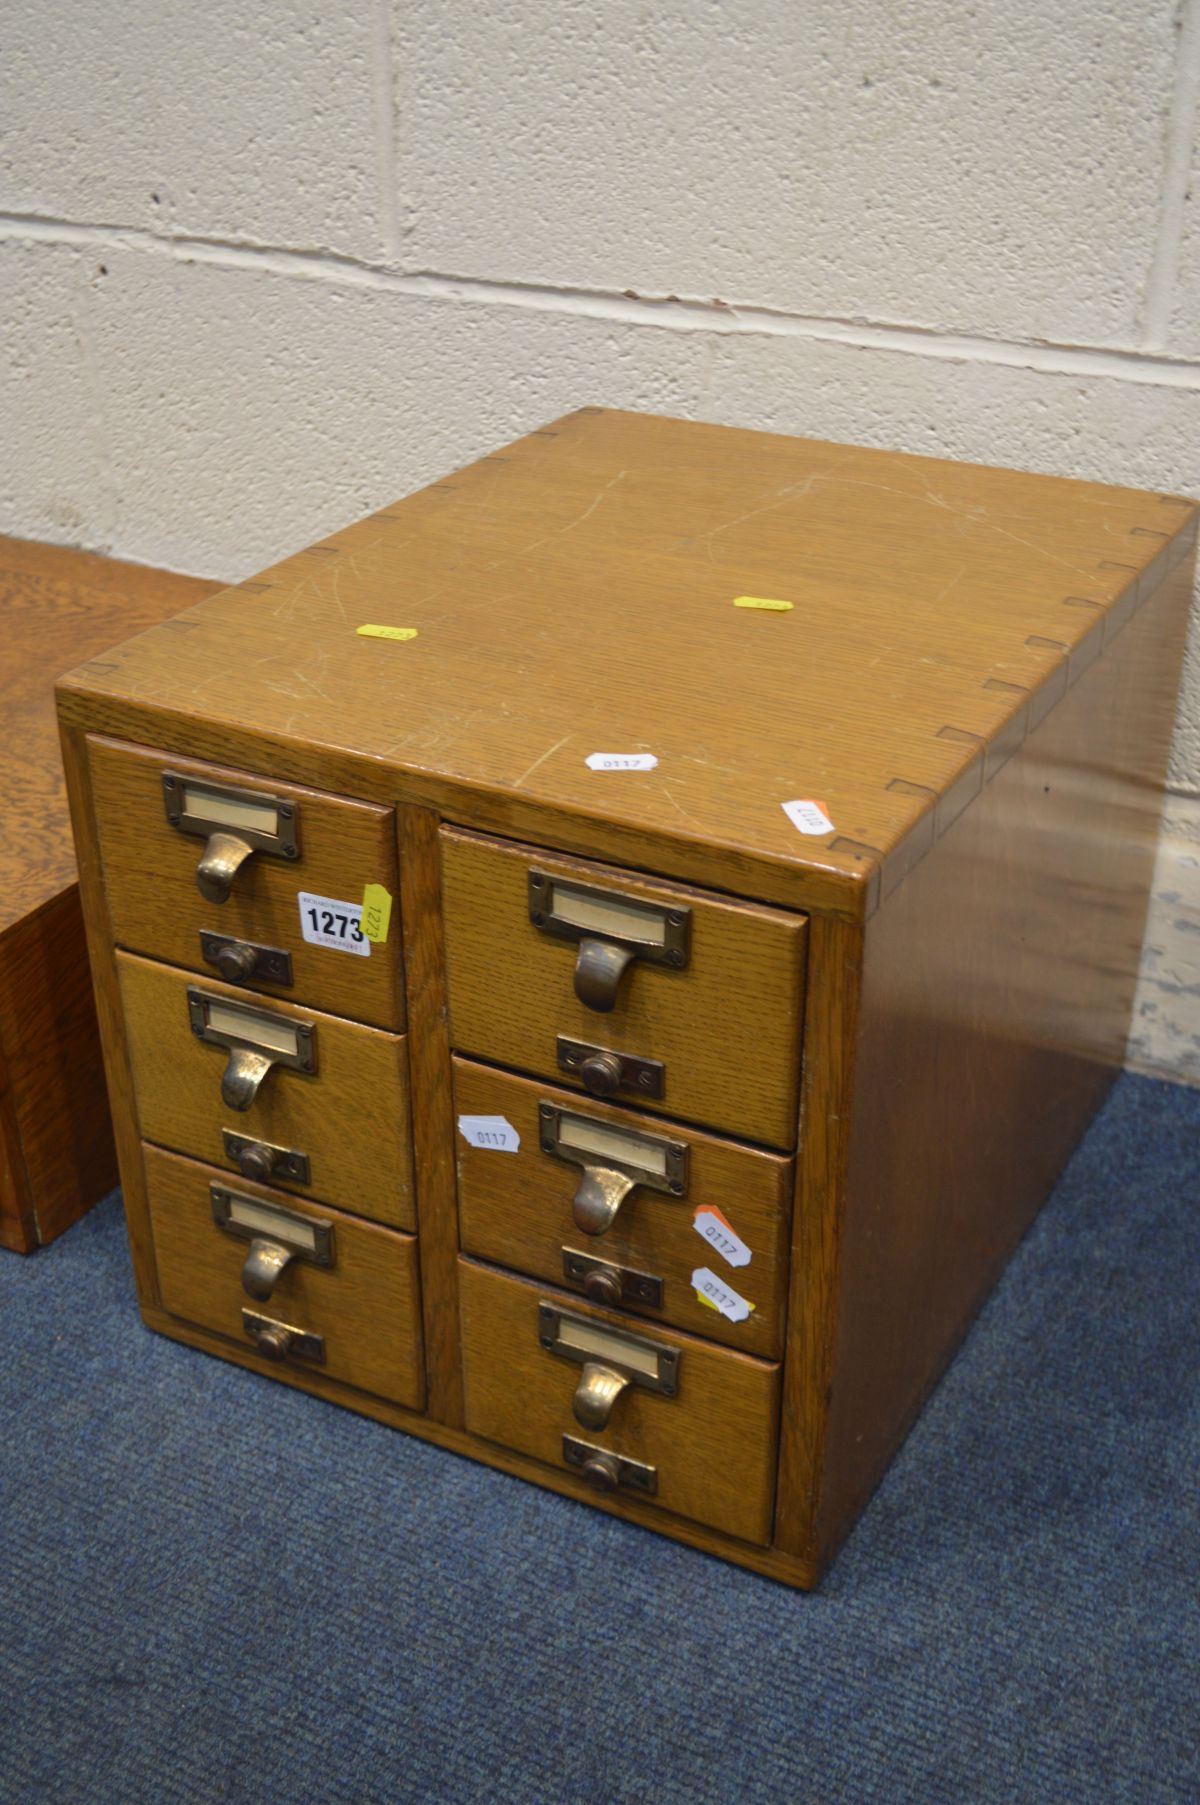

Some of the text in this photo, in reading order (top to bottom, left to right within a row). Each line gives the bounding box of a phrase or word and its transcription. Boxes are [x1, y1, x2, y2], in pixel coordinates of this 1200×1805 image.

[603, 760, 641, 768] 0117
[307, 908, 364, 942] 1273
[366, 906, 382, 939] 1273
[476, 1131, 507, 1146] 0117
[705, 1226, 737, 1254] 0117
[703, 1282, 736, 1309] 0117
